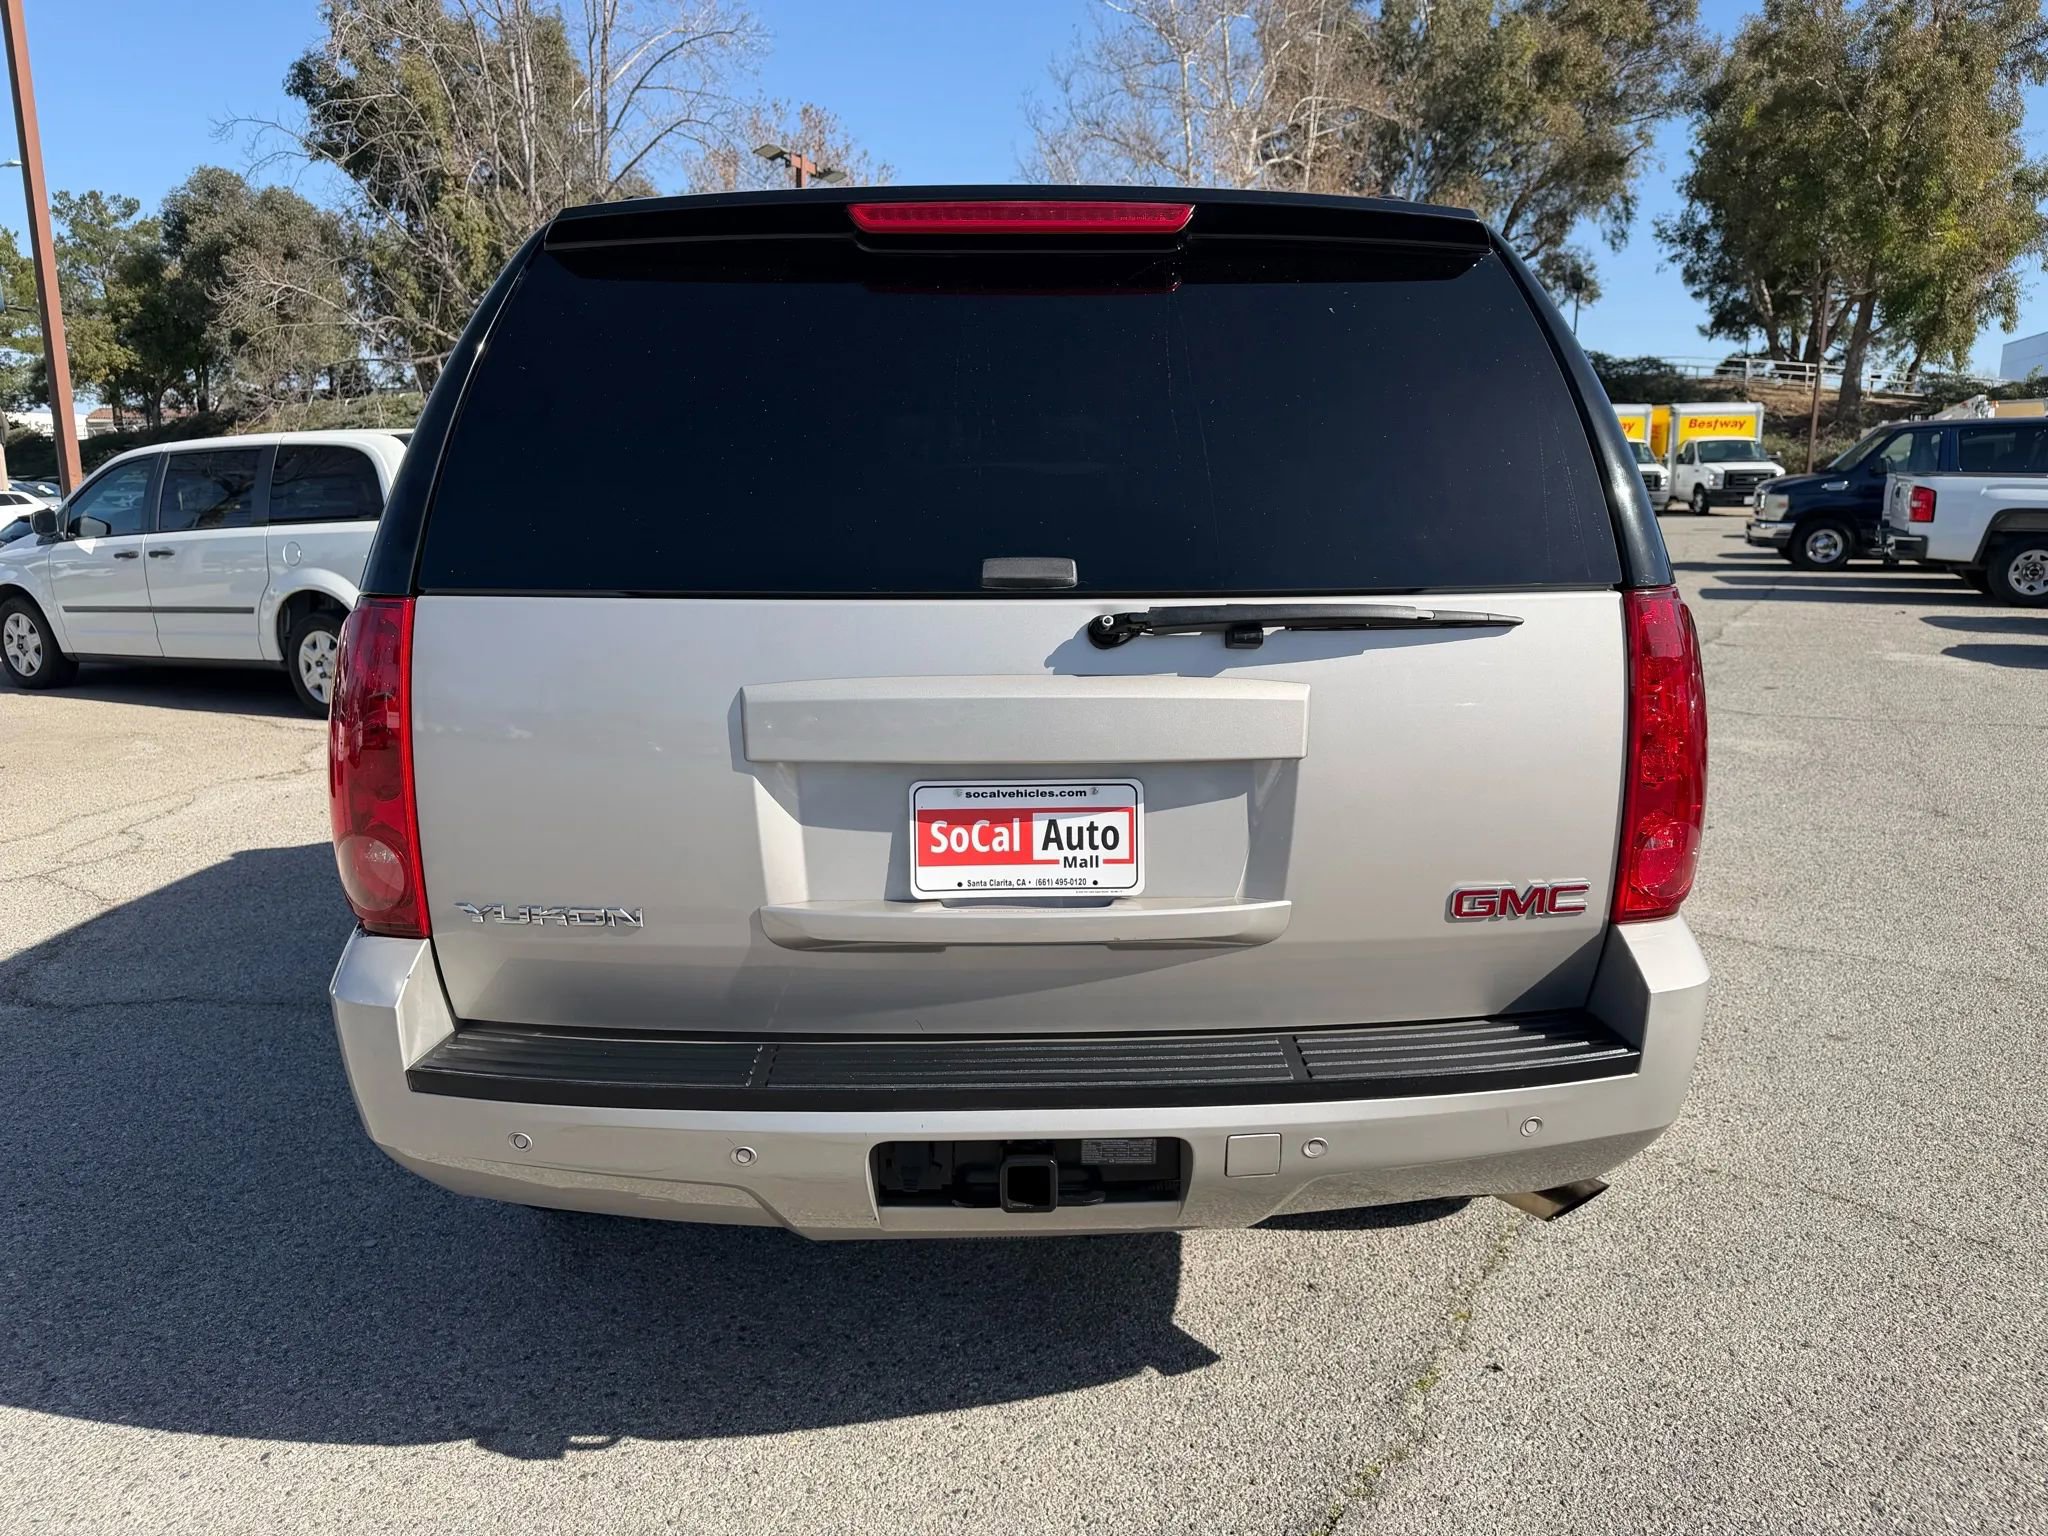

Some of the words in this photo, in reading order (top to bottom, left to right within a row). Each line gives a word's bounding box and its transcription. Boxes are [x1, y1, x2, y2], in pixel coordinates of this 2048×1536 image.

[1688, 418, 1746, 431] Bestway
[965, 788, 1087, 799] socalvehicles.com
[930, 817, 1021, 854] SoCal
[1041, 818, 1120, 851] Auto
[1063, 855, 1099, 869] Mall
[967, 879, 988, 887] Santa
[989, 879, 1015, 888] Clarita,
[1016, 879, 1027, 887] CA
[1035, 878, 1053, 887] (661)
[1055, 878, 1087, 886] 495-0120
[1450, 878, 1591, 919] GMC
[454, 902, 644, 928] YUKON
